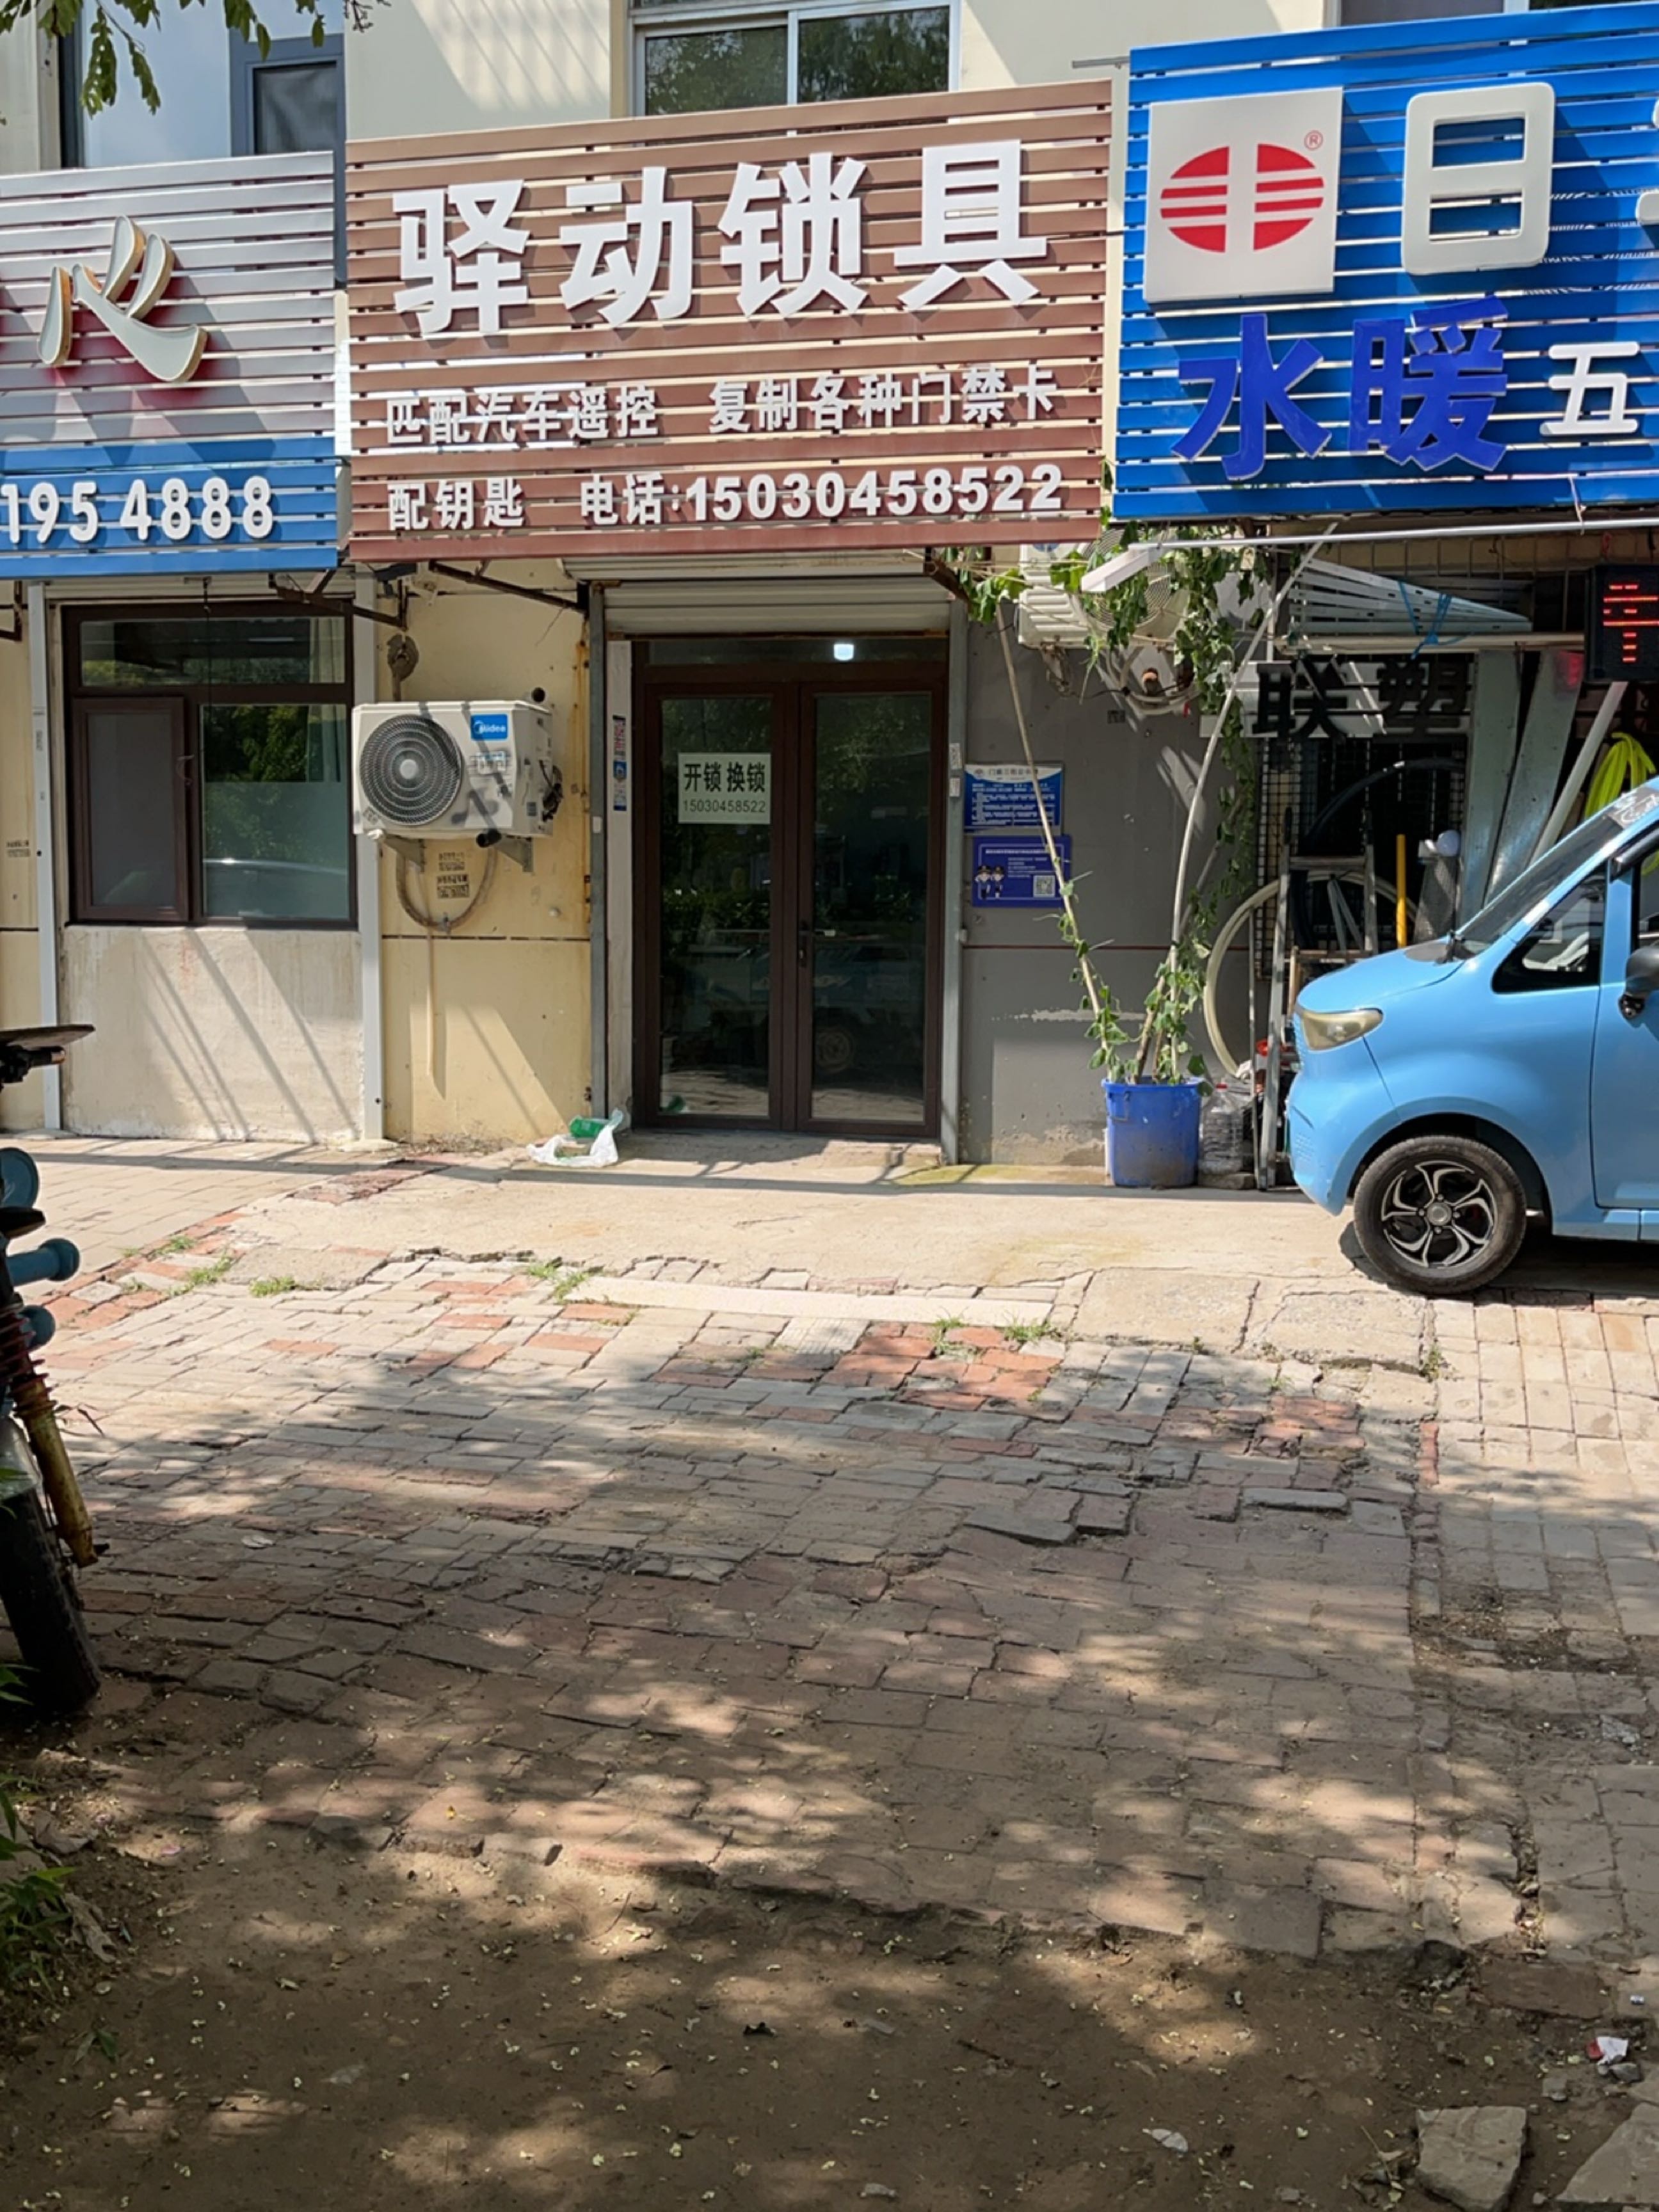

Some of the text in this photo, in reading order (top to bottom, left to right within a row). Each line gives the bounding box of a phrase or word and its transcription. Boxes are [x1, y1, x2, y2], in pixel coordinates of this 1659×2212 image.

[1401, 82, 1659, 275] 日
[392, 140, 1048, 335] 驿动锁具
[387, 364, 1058, 446] 匹配汽车遥控 复制各种门禁卡
[1171, 295, 1509, 481] 水暖
[120, 476, 273, 540] 4888
[389, 477, 525, 531] 配钥匙
[1251, 656, 1470, 744] 联塑
[683, 799, 766, 813] 15030458522
[684, 761, 766, 793] 开锁 换锁
